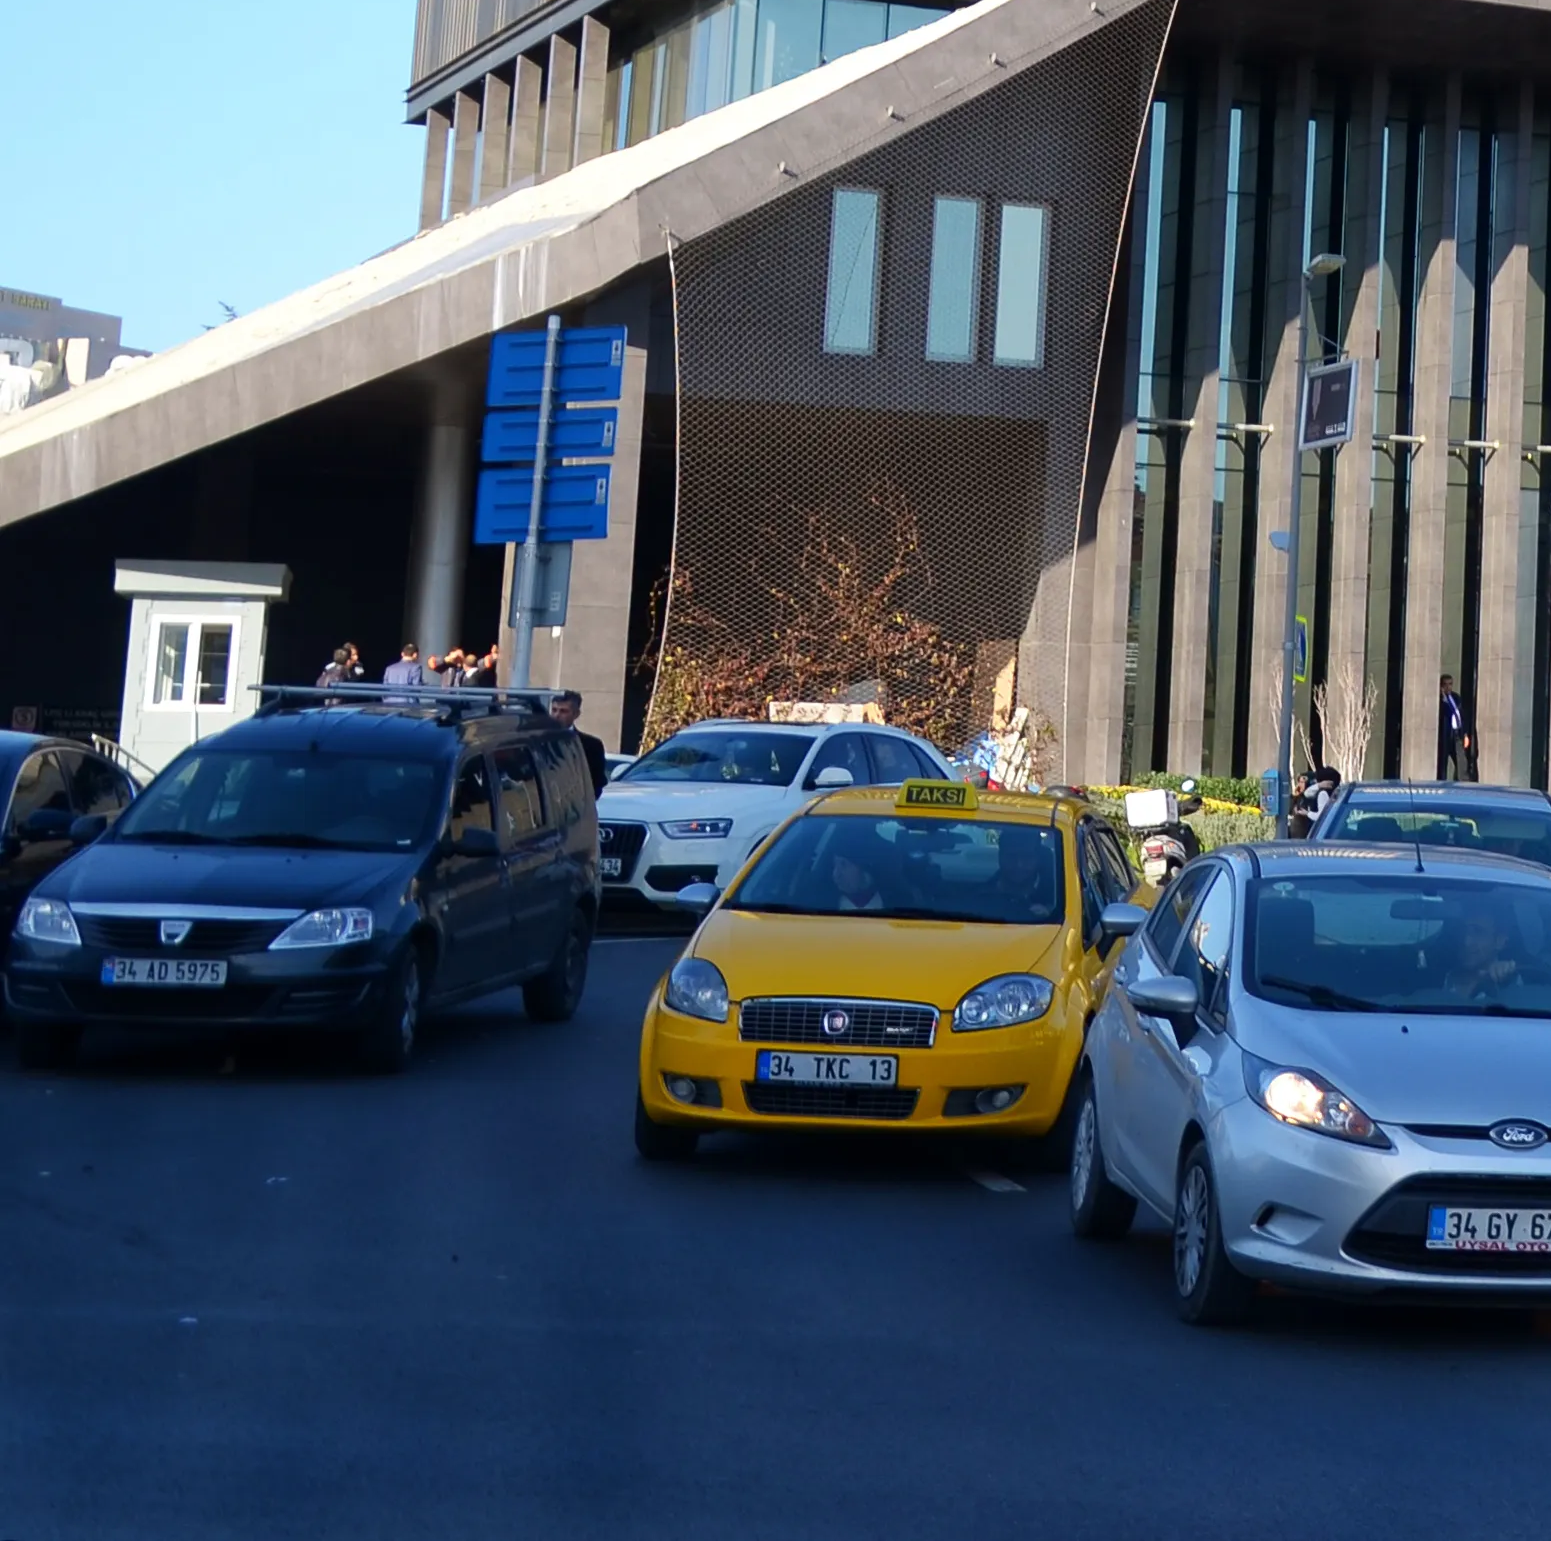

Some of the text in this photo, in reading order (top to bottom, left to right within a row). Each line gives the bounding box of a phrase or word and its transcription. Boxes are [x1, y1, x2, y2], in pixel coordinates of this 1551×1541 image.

[115, 961, 220, 982] 34 AD 5975
[771, 1055, 795, 1078] 34
[813, 1056, 851, 1080] TKC
[869, 1059, 892, 1081] 13
[1502, 1126, 1535, 1142] Ford
[1447, 1212, 1477, 1239] 34
[1488, 1212, 1518, 1240] GY
[1455, 1240, 1508, 1251] UYSAL
[1515, 1241, 1549, 1252] OTO
